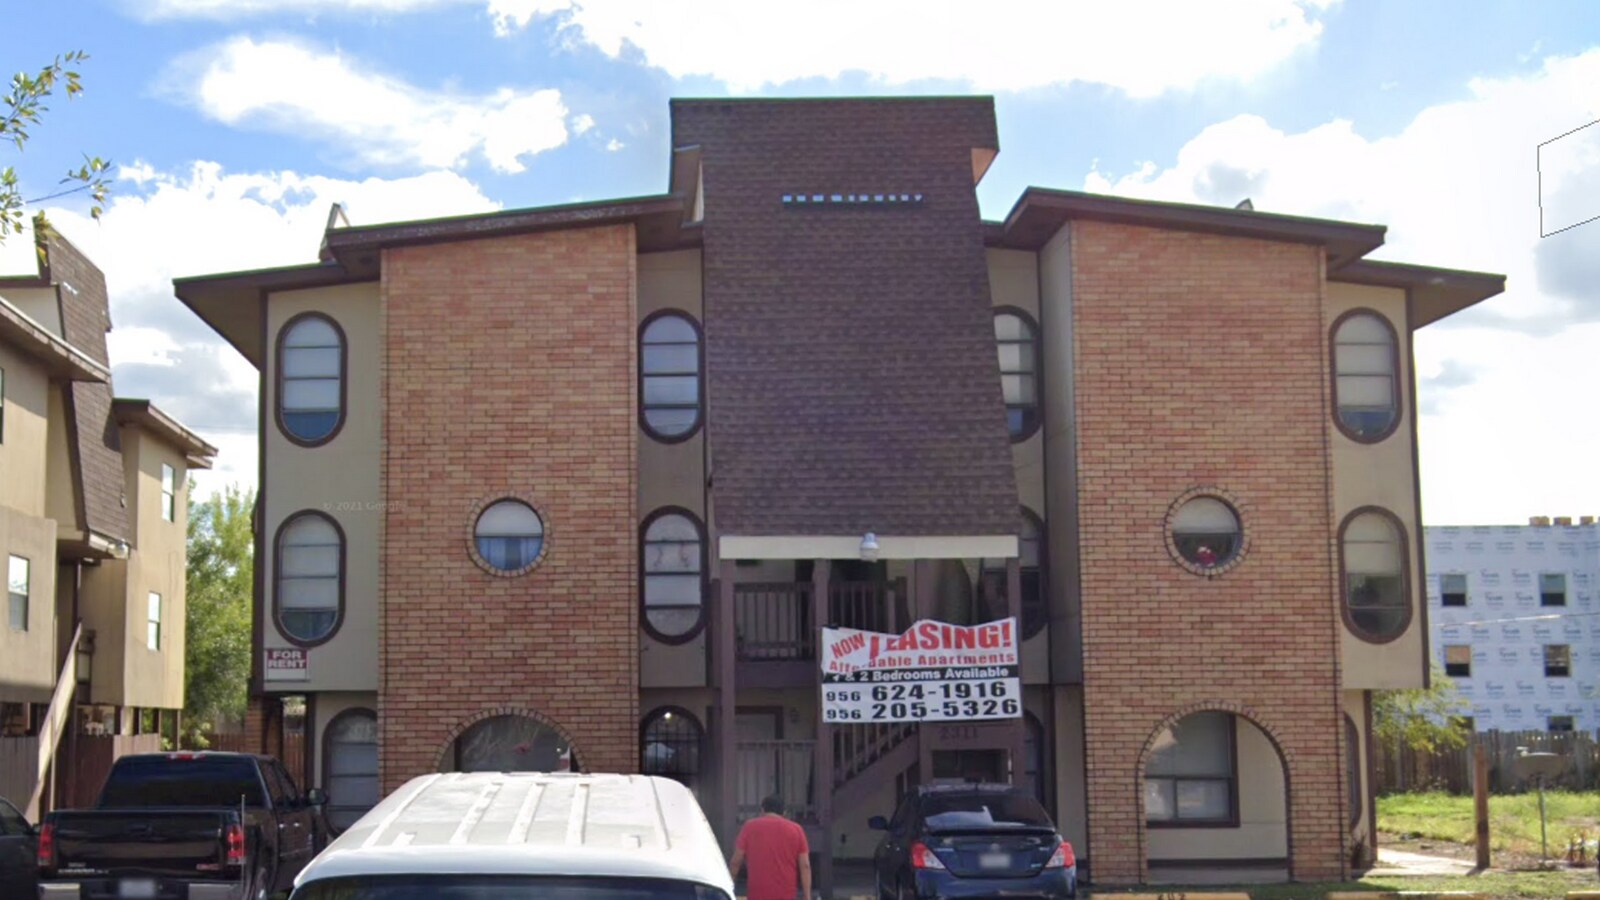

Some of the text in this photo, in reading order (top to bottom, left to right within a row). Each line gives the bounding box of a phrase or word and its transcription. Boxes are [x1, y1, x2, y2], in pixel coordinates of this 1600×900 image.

[272, 650, 302, 660] FOR
[831, 632, 866, 659] NOW
[267, 659, 306, 669] RENT
[829, 653, 1016, 673] Affdable Apartments
[859, 671, 870, 682] 2
[872, 669, 941, 682] Bedrooms
[944, 666, 1010, 680] Available
[826, 681, 1007, 702] 956 624-1916
[826, 699, 1019, 721] 956 205-5326
